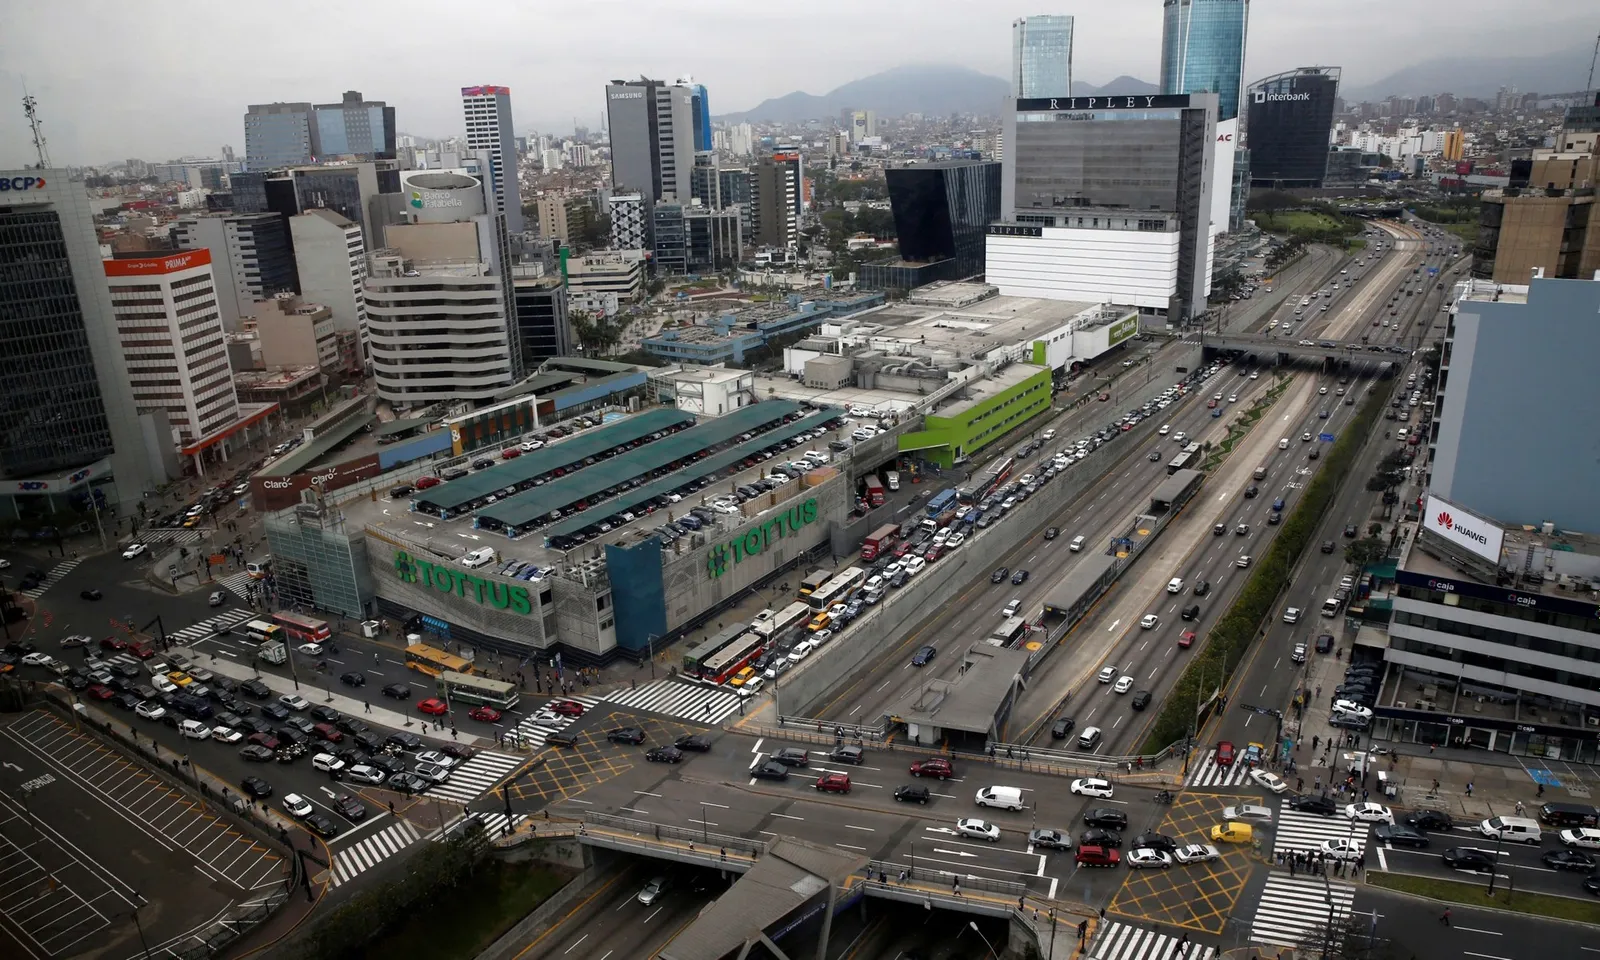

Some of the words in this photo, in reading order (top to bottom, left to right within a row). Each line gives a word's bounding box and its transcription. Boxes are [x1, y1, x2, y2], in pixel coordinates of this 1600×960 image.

[611, 92, 643, 100] SAMSUNG
[1266, 92, 1310, 102] Interbank
[1050, 96, 1155, 110] RIPLEY
[0, 176, 35, 191] BCP
[423, 191, 451, 200] Banco
[425, 198, 462, 208] Falabella
[990, 226, 1038, 236] RIPLEY
[165, 257, 187, 269] PRIMA
[311, 471, 334, 485] Claro
[264, 480, 289, 489] Claro
[730, 497, 818, 564] TOTTUS
[1454, 523, 1487, 545] HUAWEI
[416, 558, 532, 616] TOTTUS
[1436, 582, 1455, 591] caja
[1516, 596, 1537, 606] caja
